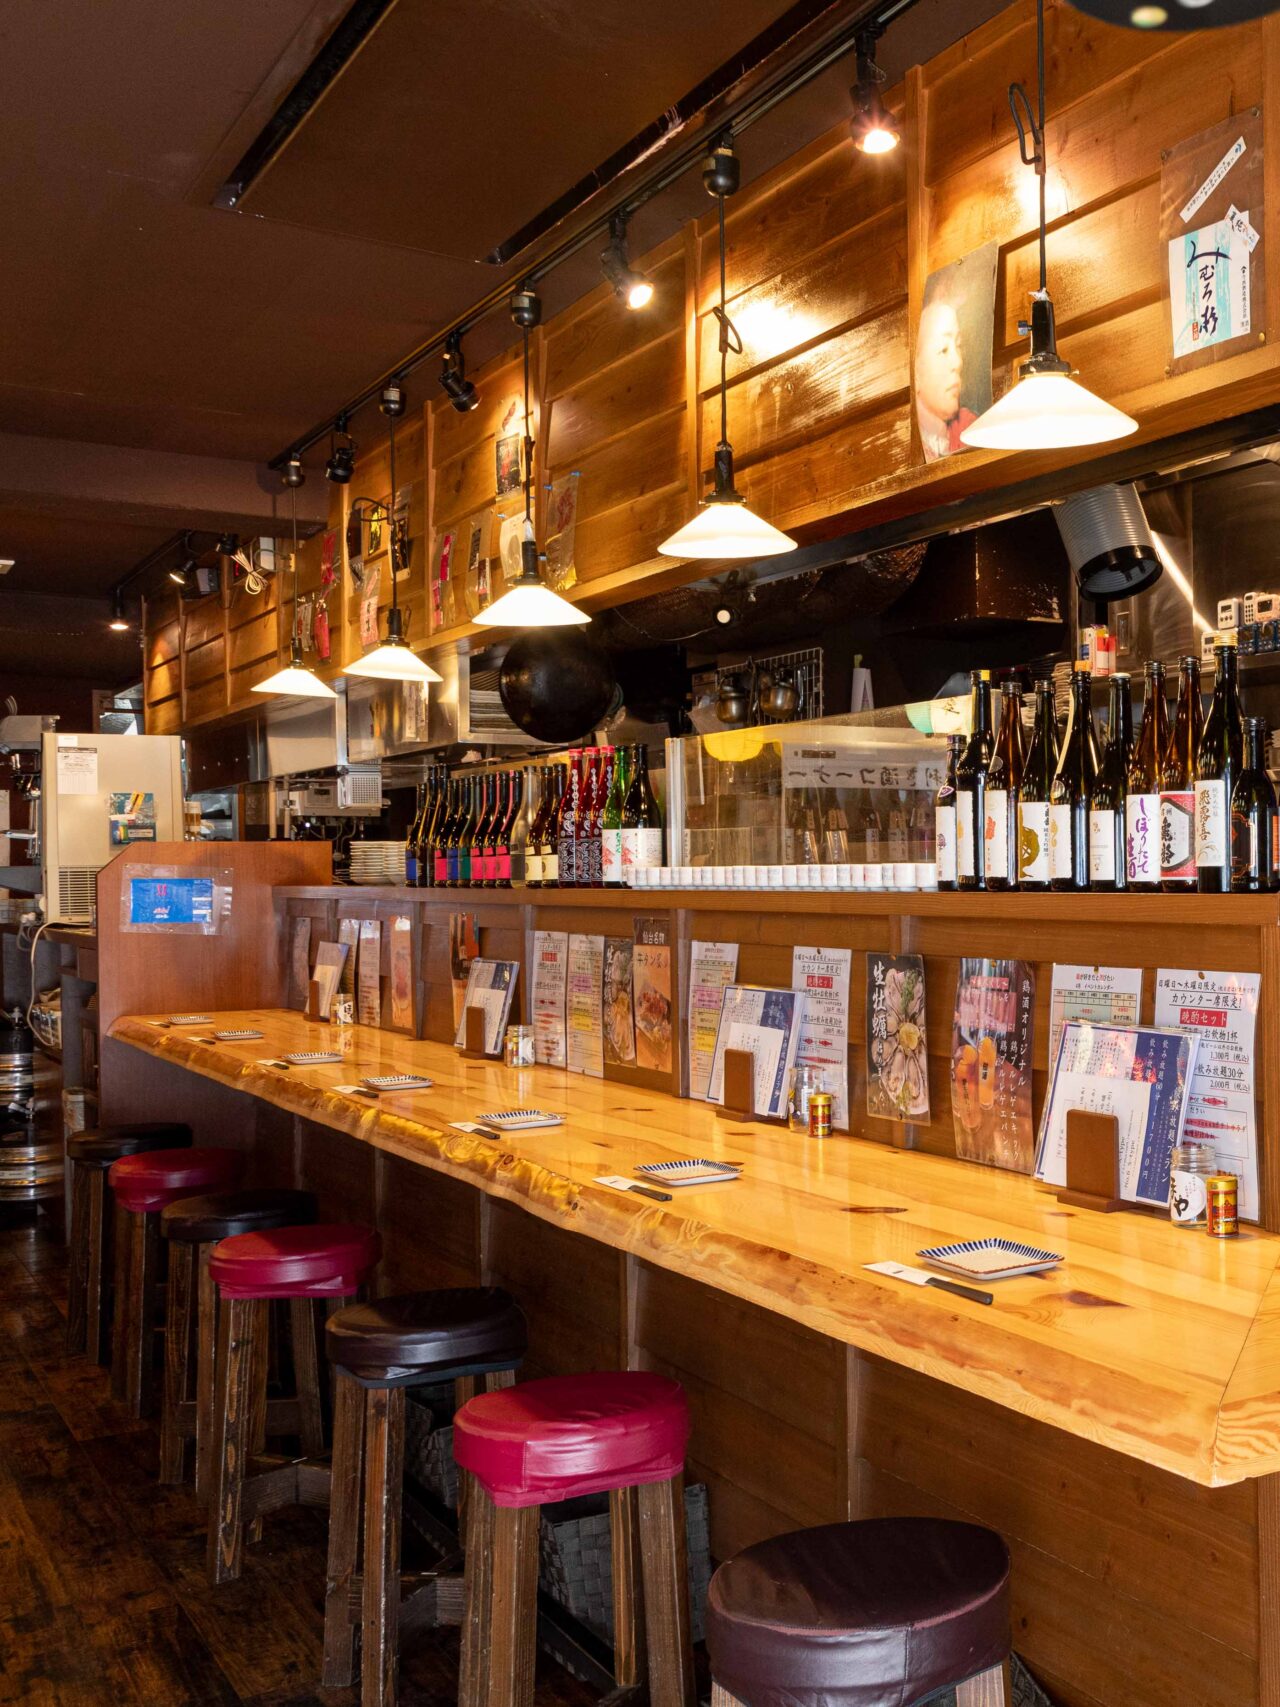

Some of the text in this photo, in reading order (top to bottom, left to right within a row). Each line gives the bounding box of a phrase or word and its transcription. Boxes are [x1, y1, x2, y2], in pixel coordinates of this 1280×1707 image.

[1136, 797, 1150, 874] しぼりたて
[872, 961, 888, 1040] 生牡蠣
[1172, 993, 1242, 1009] カウンター席限定!
[1181, 1010, 1227, 1026] 晩酌セット
